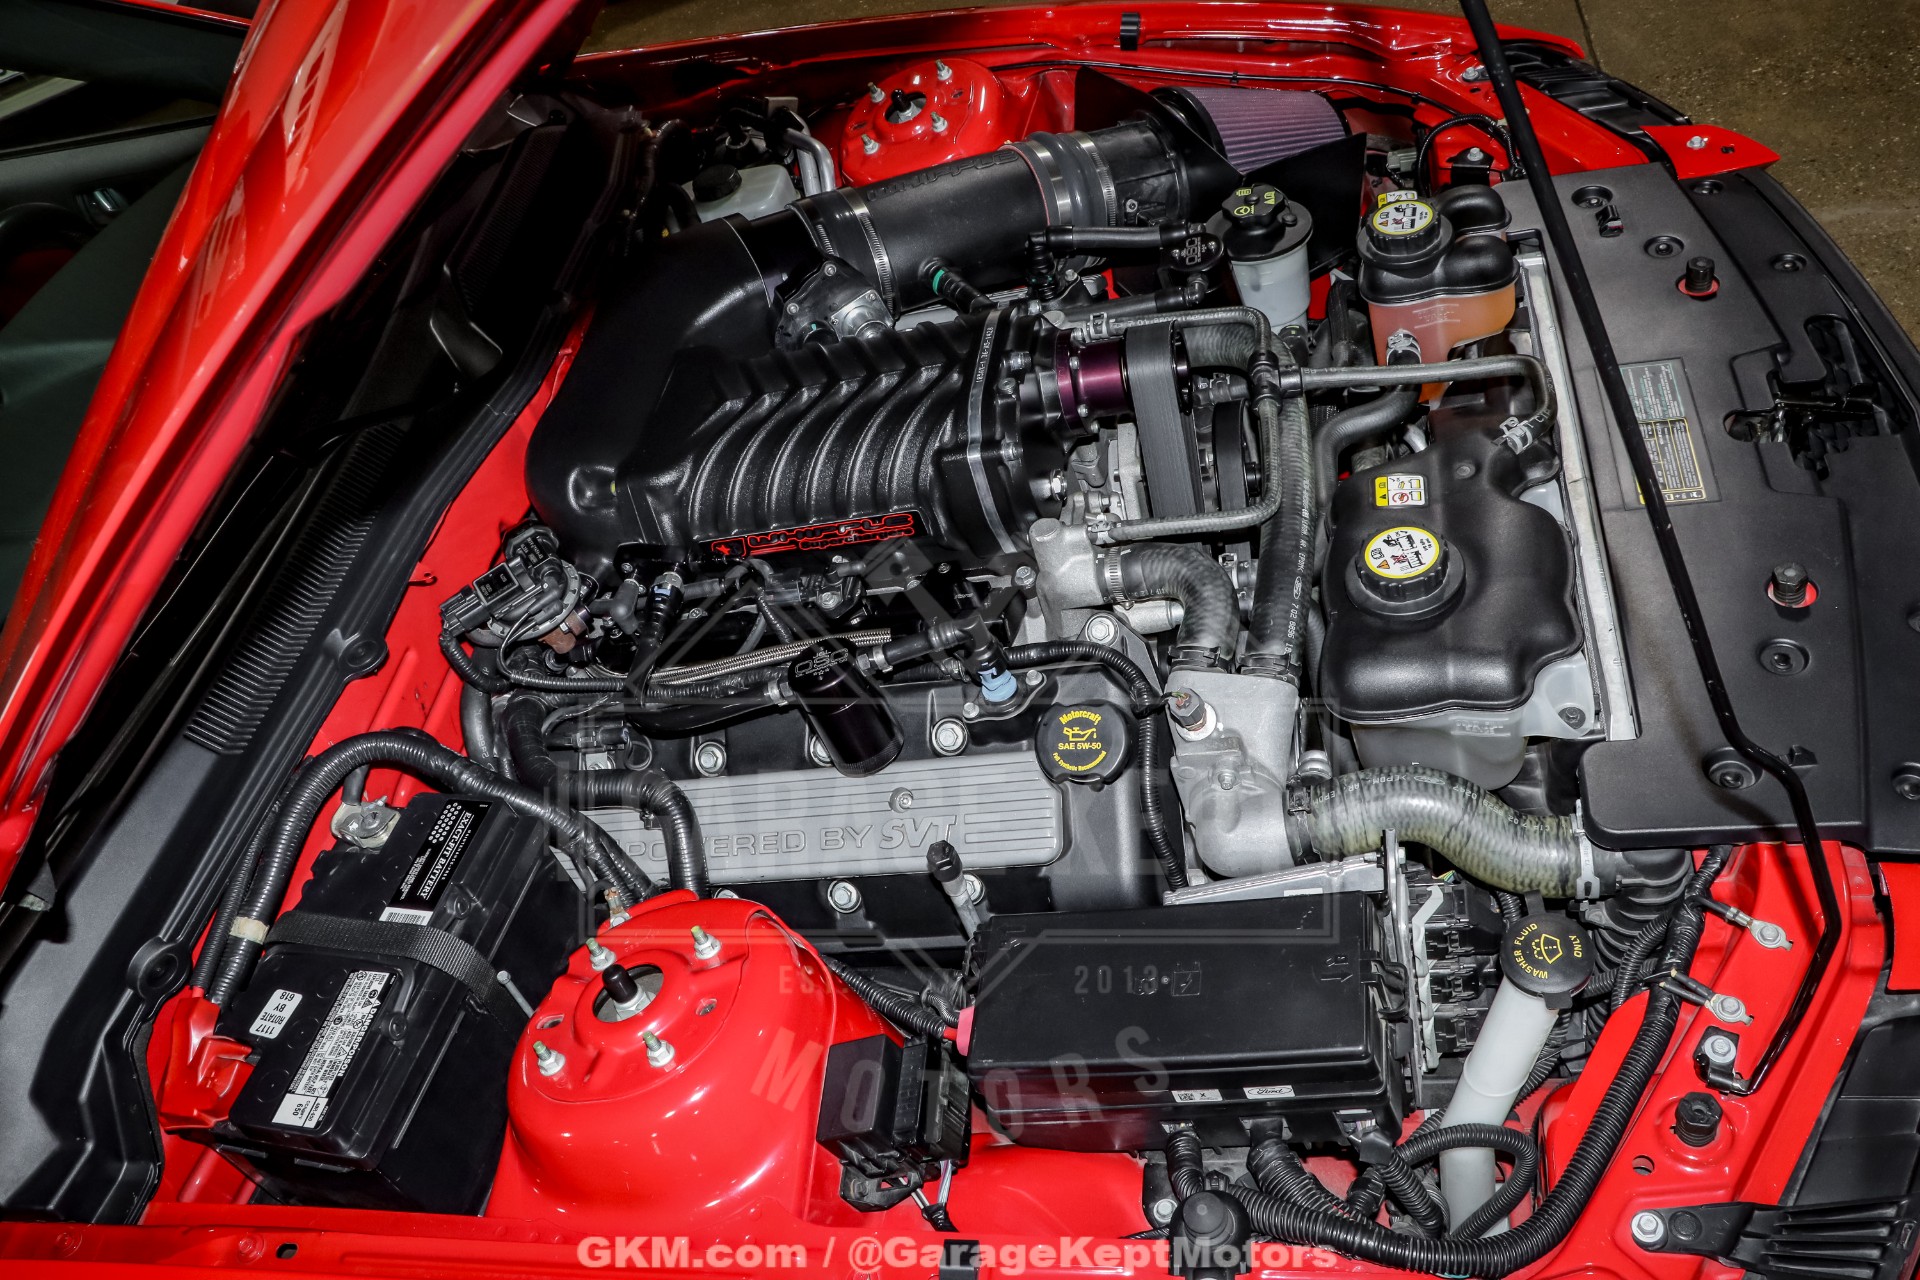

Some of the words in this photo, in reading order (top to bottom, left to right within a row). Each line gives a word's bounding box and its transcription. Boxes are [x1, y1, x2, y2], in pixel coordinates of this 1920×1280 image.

[1059, 710, 1102, 726] Motorcraft
[1058, 742, 1075, 750] SAE
[1076, 742, 1102, 750] 5W-50
[442, 811, 473, 857] EXACT-FIT
[625, 829, 806, 860] POERED
[820, 824, 873, 851] BY
[879, 815, 958, 850] SVT
[420, 857, 447, 899] BATTERY
[1514, 922, 1538, 946] FLUID
[1569, 935, 1583, 958] ONLY
[1513, 949, 1548, 980] WASHER
[279, 991, 295, 1002] 618
[273, 1003, 287, 1012] BY
[260, 1011, 286, 1025] ROTATE
[255, 1023, 275, 1035] 1117
[292, 1103, 304, 1117] 650
